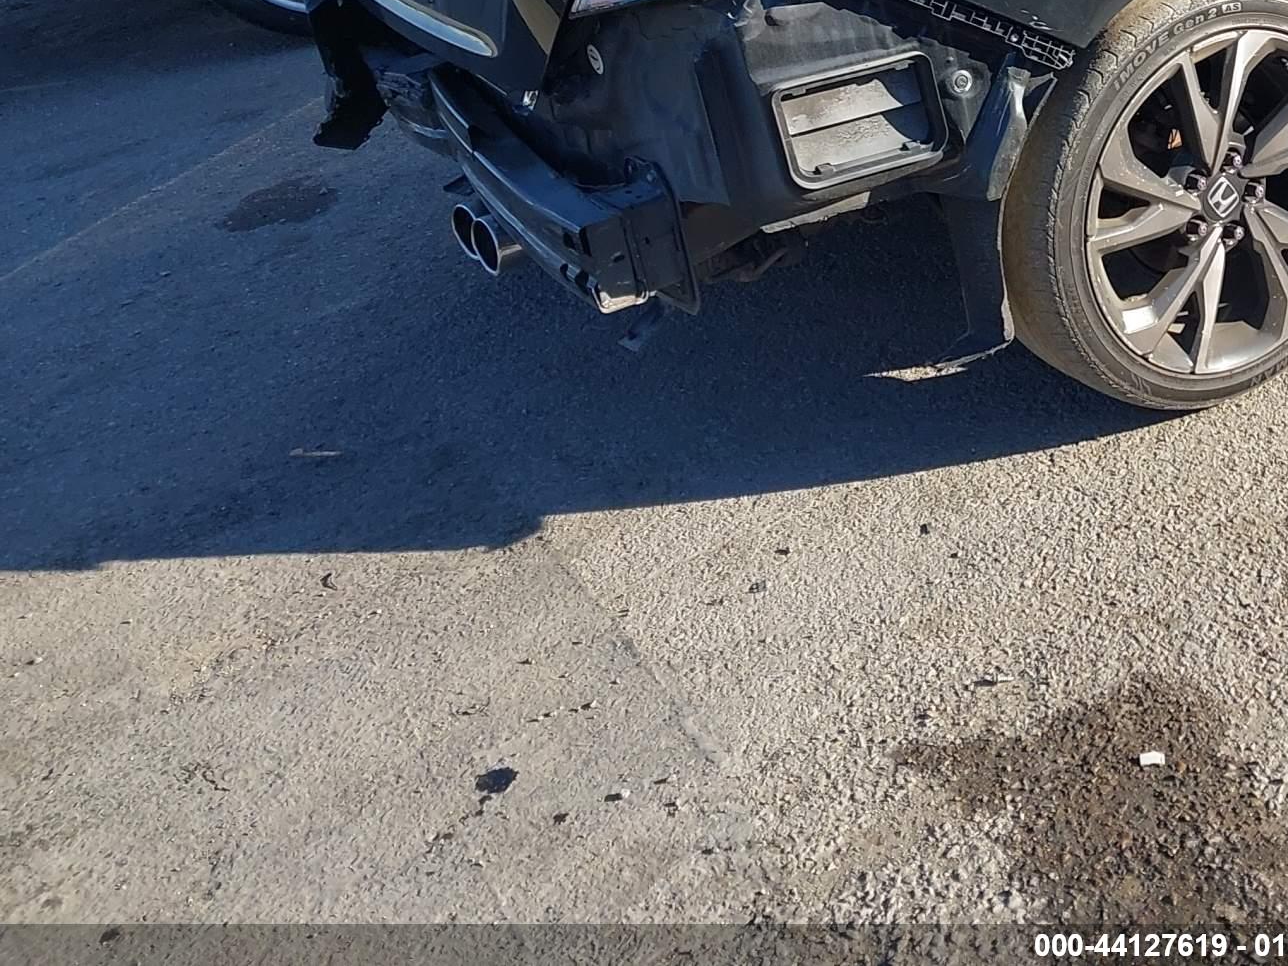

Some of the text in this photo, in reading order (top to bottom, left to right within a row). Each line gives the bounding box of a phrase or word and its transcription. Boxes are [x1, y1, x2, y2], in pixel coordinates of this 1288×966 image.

[1173, 15, 1205, 35] Gen
[1207, 7, 1218, 19] 2
[1223, 2, 1241, 13] AS
